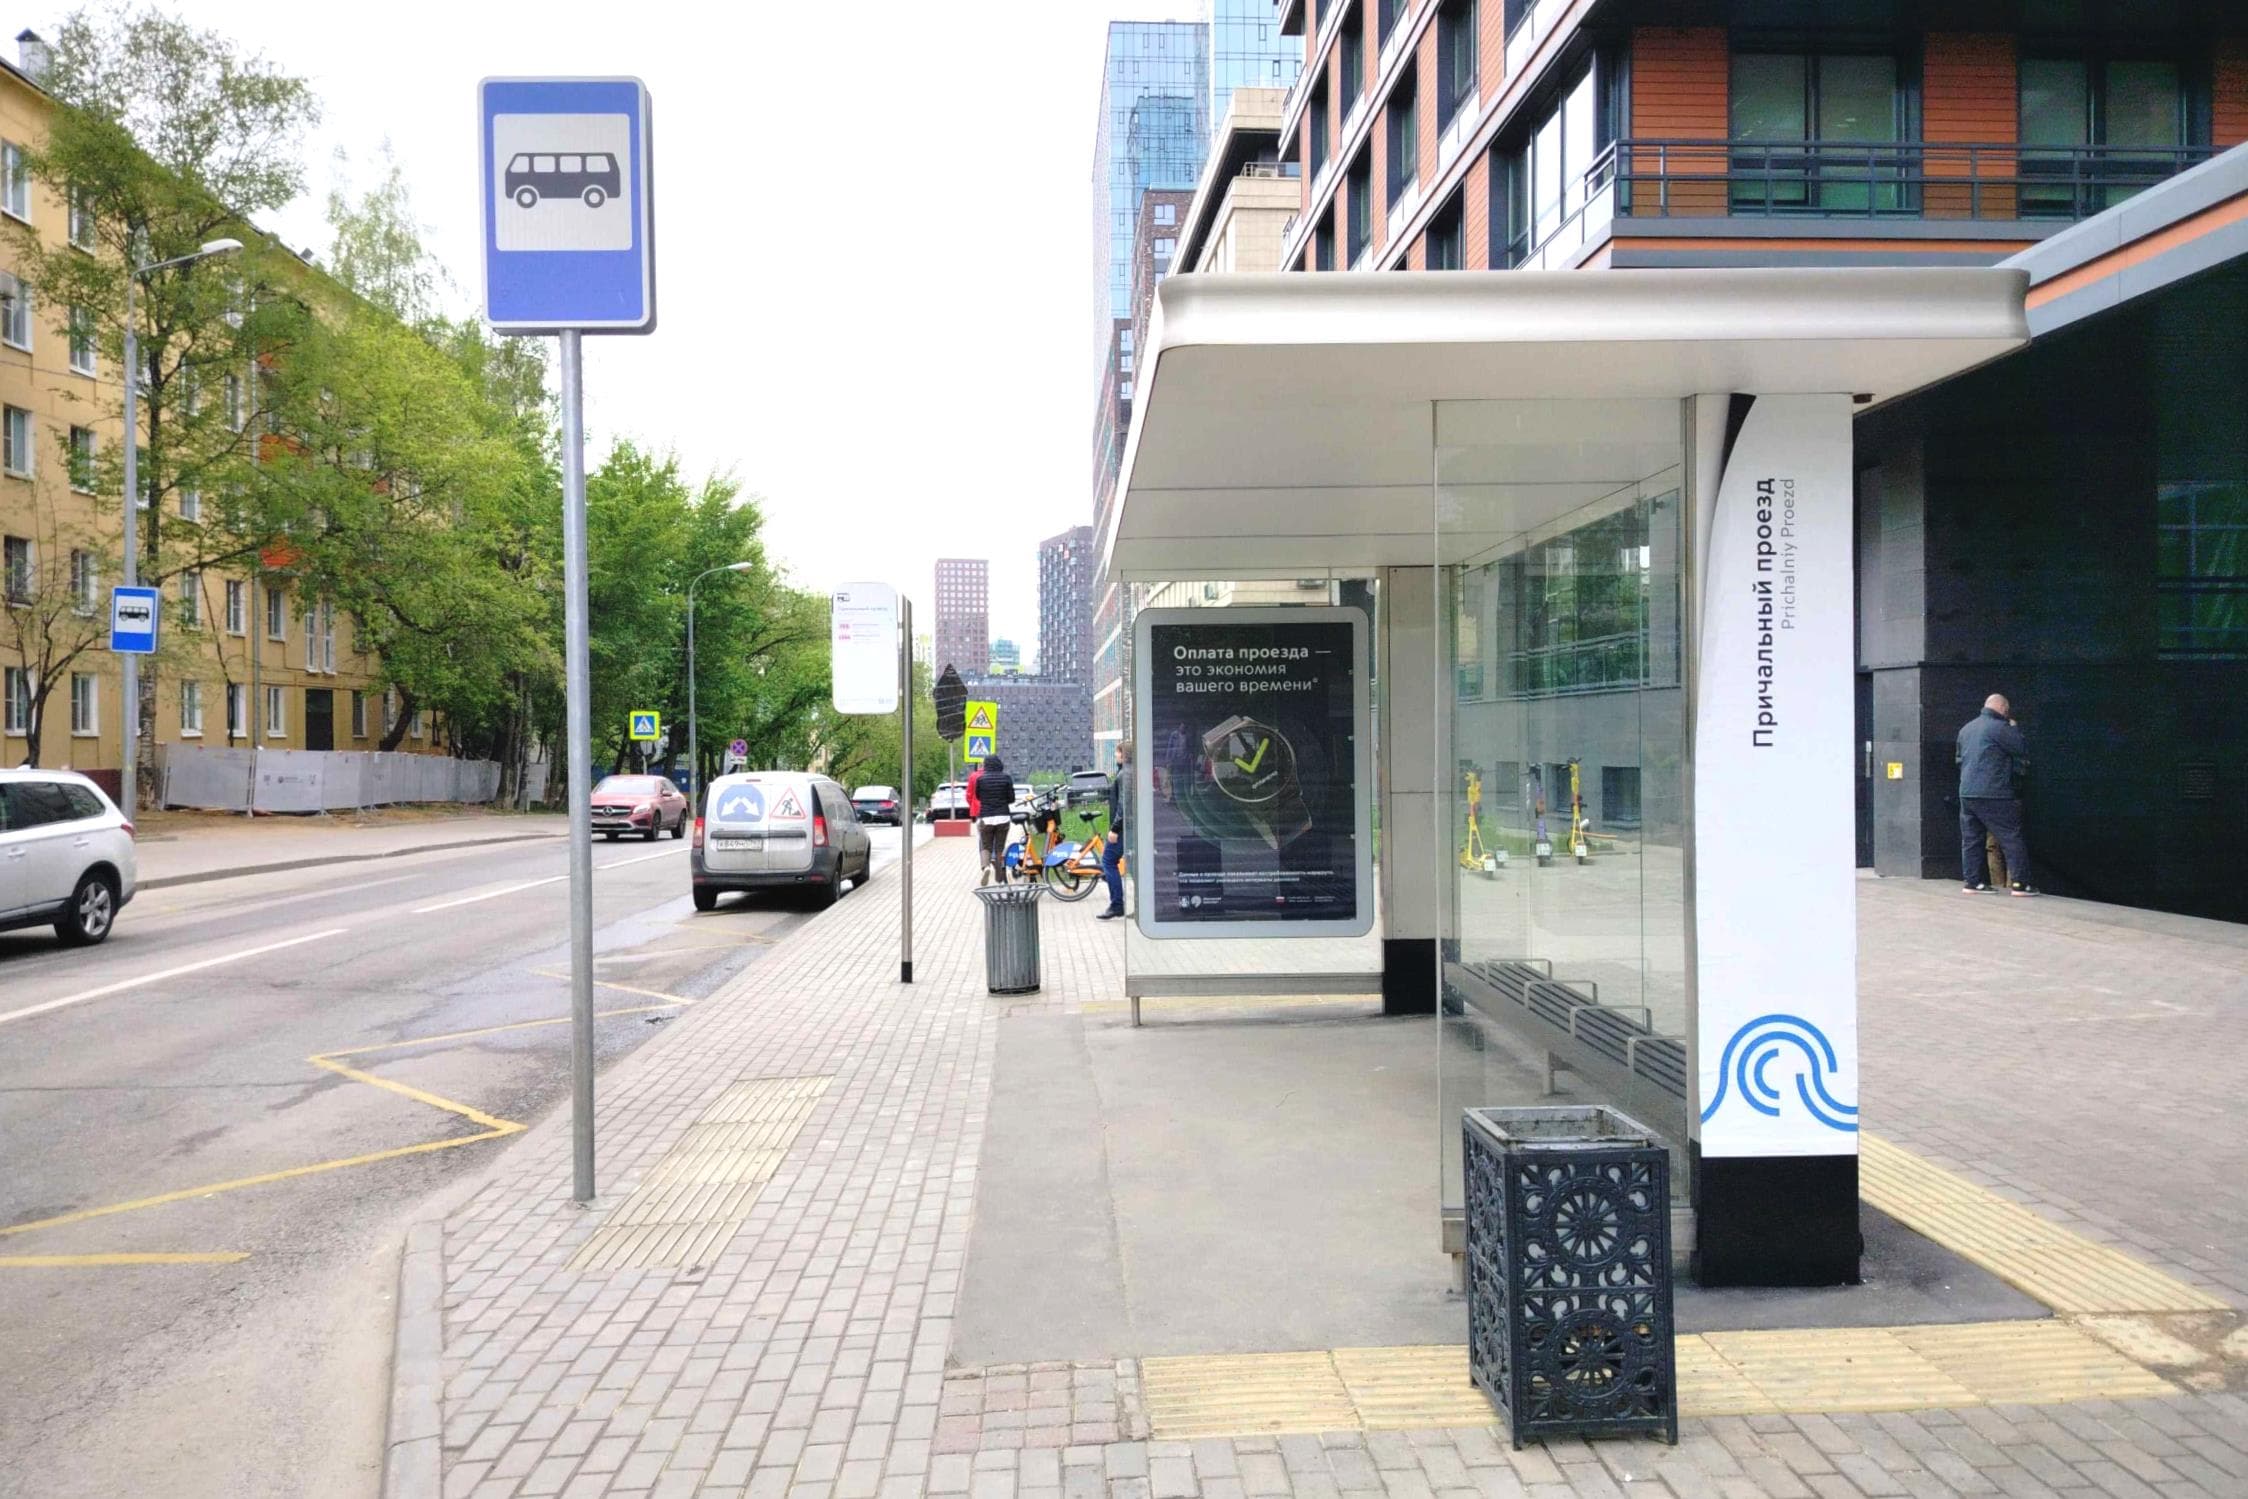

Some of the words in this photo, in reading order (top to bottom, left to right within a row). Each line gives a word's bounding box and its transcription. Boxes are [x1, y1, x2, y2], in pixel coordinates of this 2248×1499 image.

[1755, 478, 1777, 572] проезд
[1779, 478, 1795, 538] Proezd
[1780, 542, 1797, 630] Prichalniy
[1173, 645, 1234, 660] Оплата
[1239, 646, 1309, 662] проезда
[1175, 665, 1202, 677] это
[1206, 664, 1287, 676] экономия
[1752, 580, 1777, 748] Причальный
[1176, 681, 1235, 693] вашего
